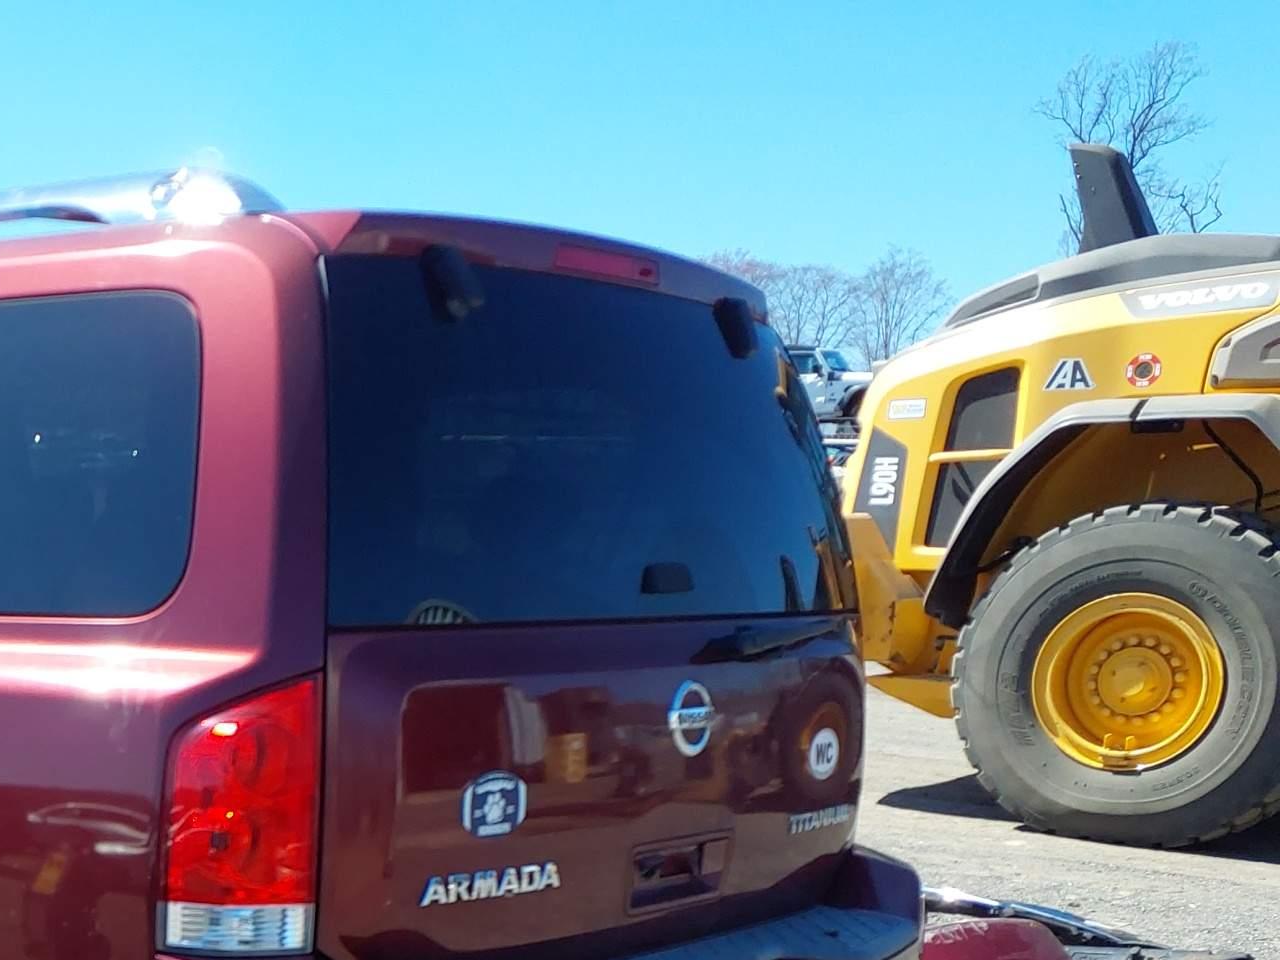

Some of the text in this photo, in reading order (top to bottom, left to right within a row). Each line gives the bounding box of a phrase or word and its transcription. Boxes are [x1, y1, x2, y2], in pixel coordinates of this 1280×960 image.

[1138, 282, 1270, 310] VOLVO
[816, 742, 833, 765] WC
[420, 861, 560, 907] ARMADA
